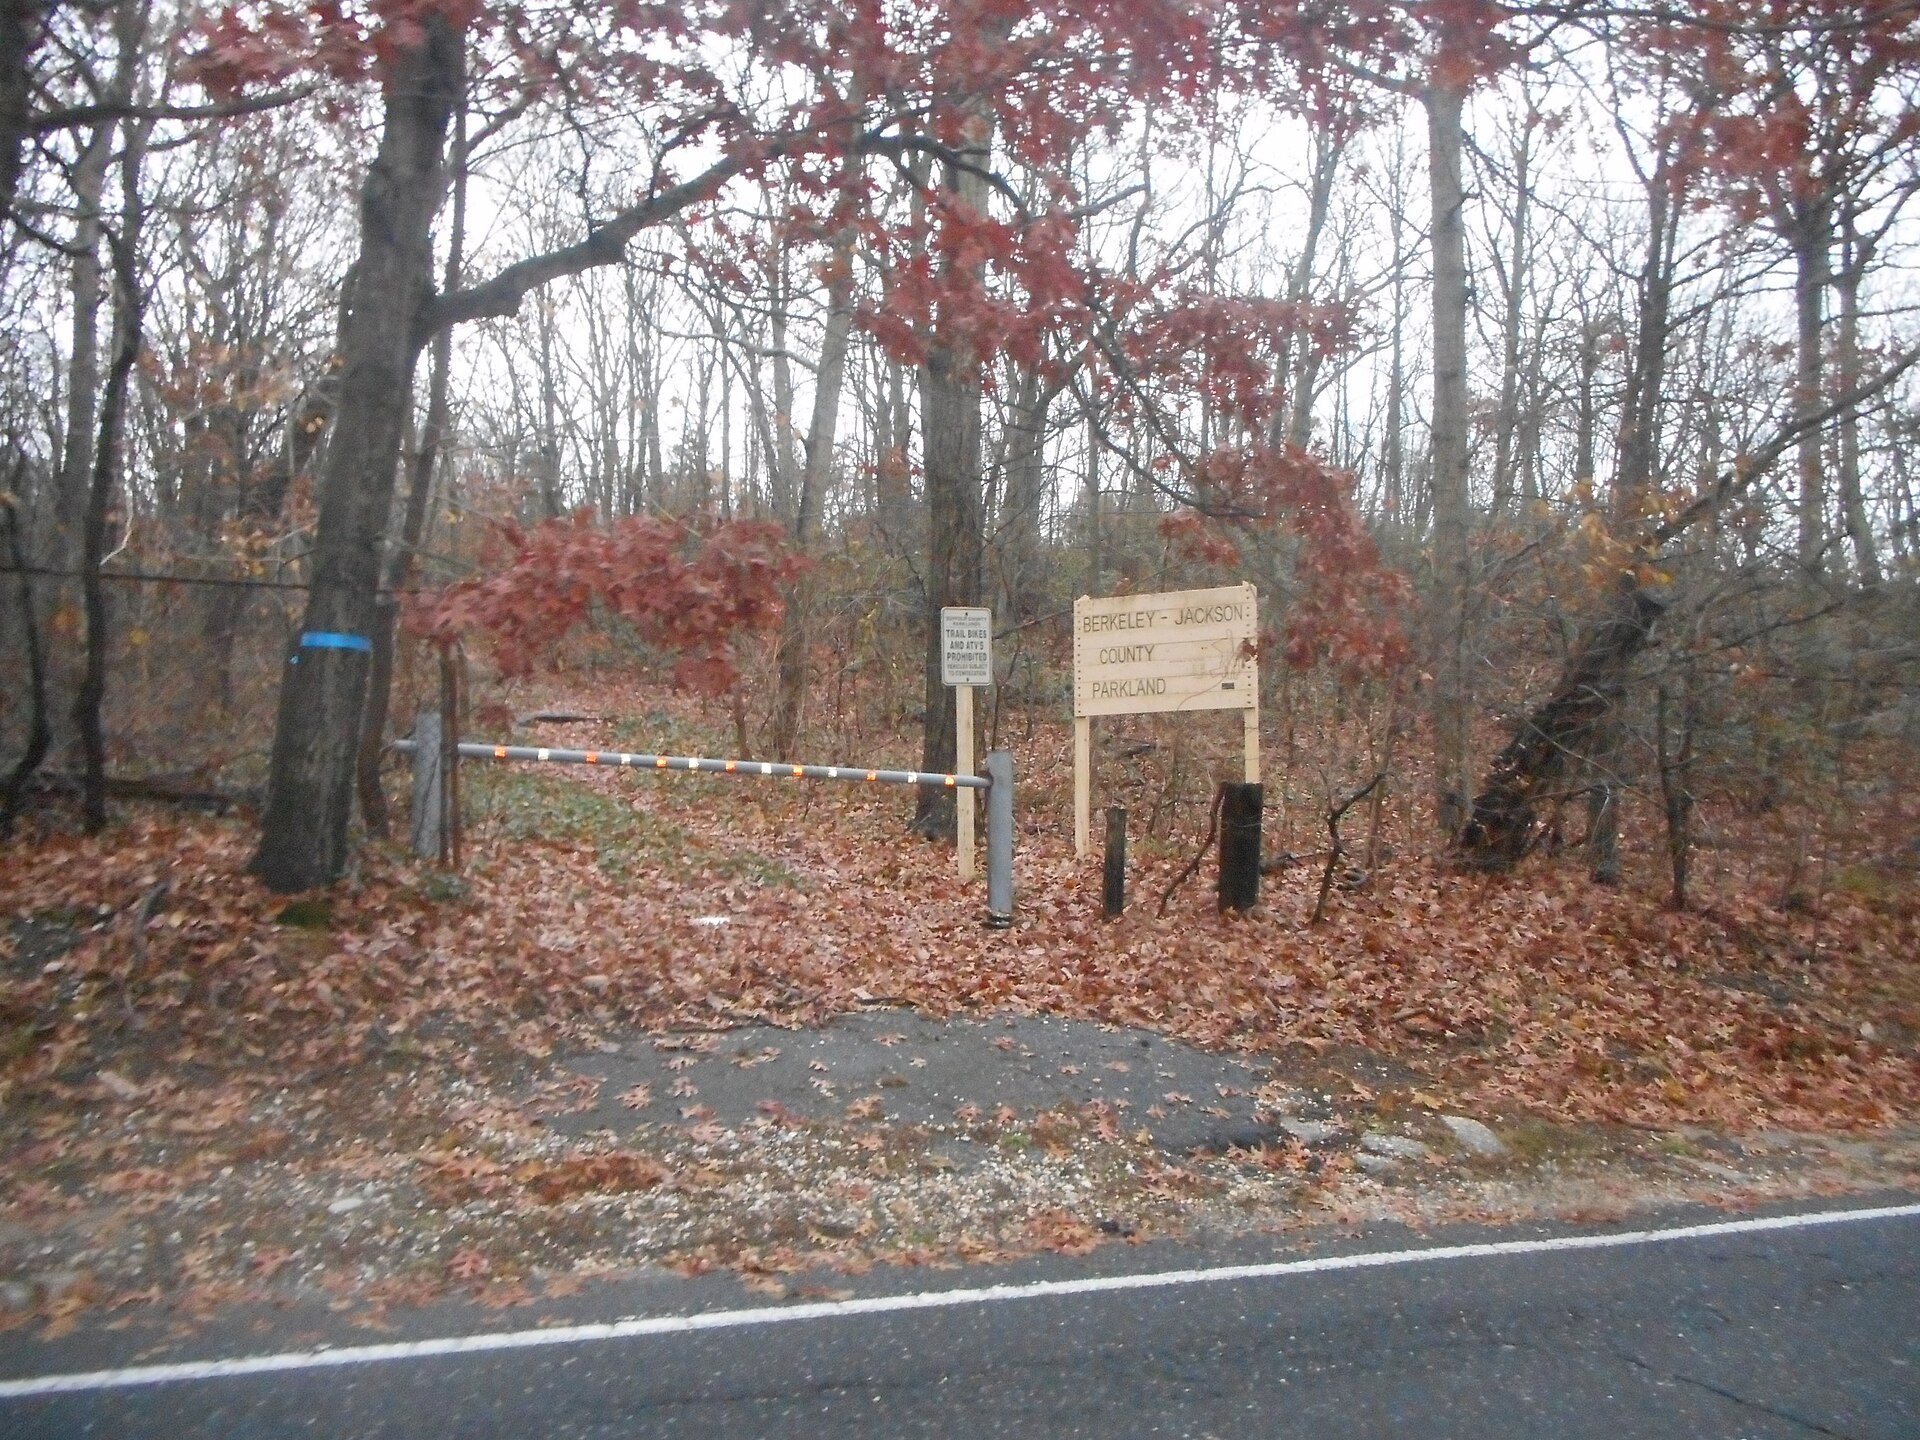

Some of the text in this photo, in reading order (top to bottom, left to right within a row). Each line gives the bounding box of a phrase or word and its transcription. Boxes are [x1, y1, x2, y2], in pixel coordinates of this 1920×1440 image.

[1083, 611, 1156, 633] BERKELEY
[1174, 605, 1243, 626] JACKSON
[946, 629, 987, 638] TRAIL BIKES
[950, 641, 964, 650] AND
[946, 652, 987, 661] PROHIBITED
[1099, 645, 1155, 665] COUNTY
[1092, 678, 1166, 699] PARKLAND
